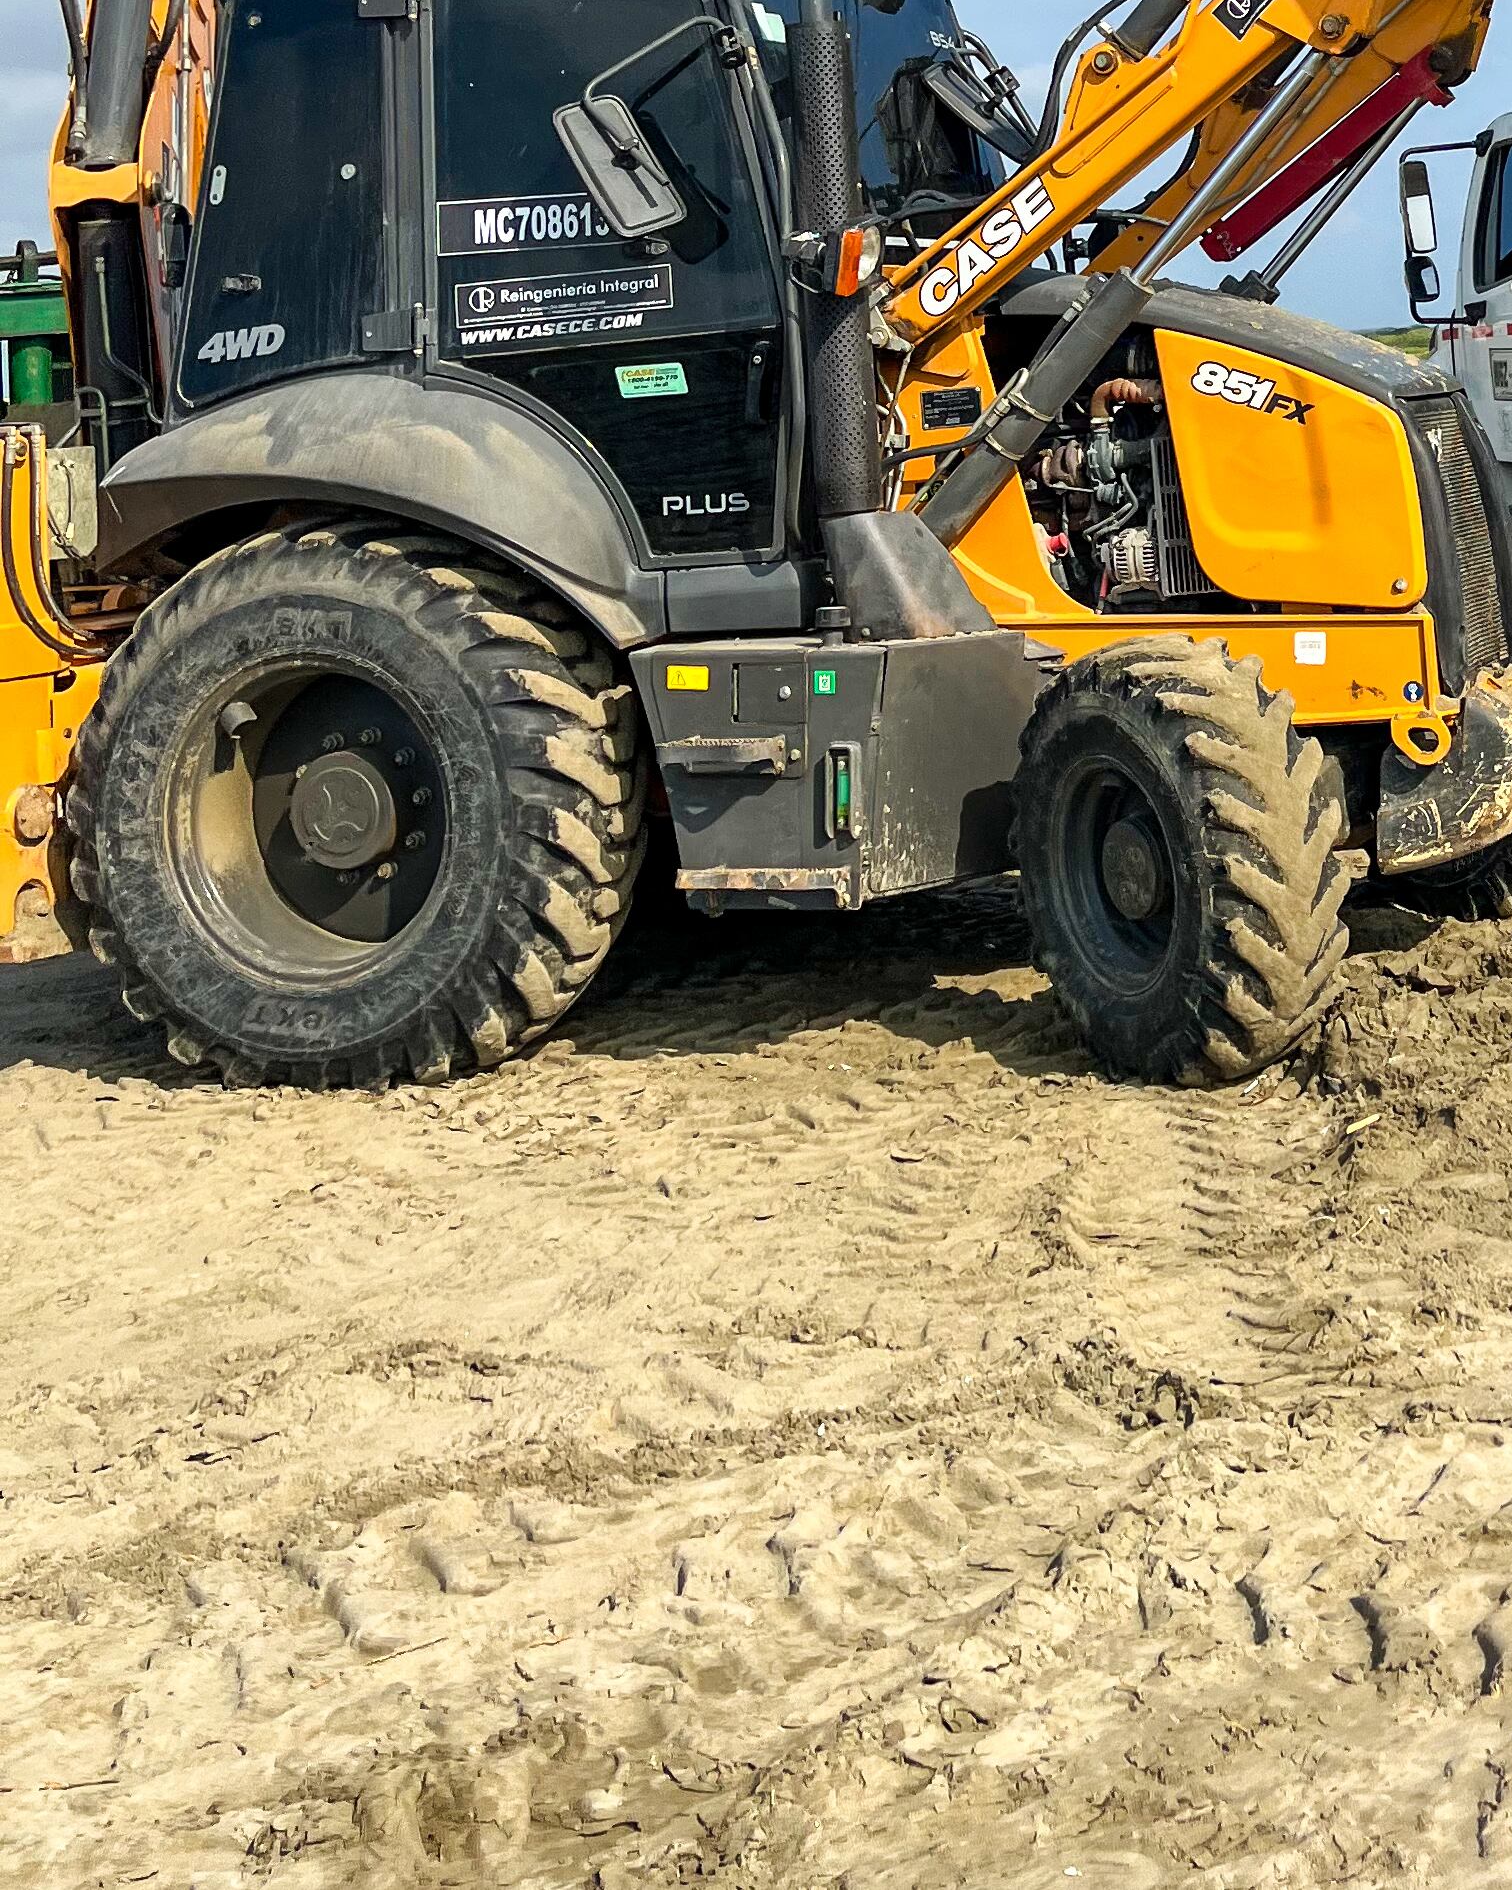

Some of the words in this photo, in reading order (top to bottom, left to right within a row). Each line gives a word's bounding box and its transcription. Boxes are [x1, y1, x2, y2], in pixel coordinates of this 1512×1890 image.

[919, 173, 1055, 316] CASE
[600, 274, 659, 294] Integral
[198, 323, 286, 363] 4WD
[461, 313, 644, 345] WWW.CASECE.COM
[663, 492, 750, 516] PLUS
